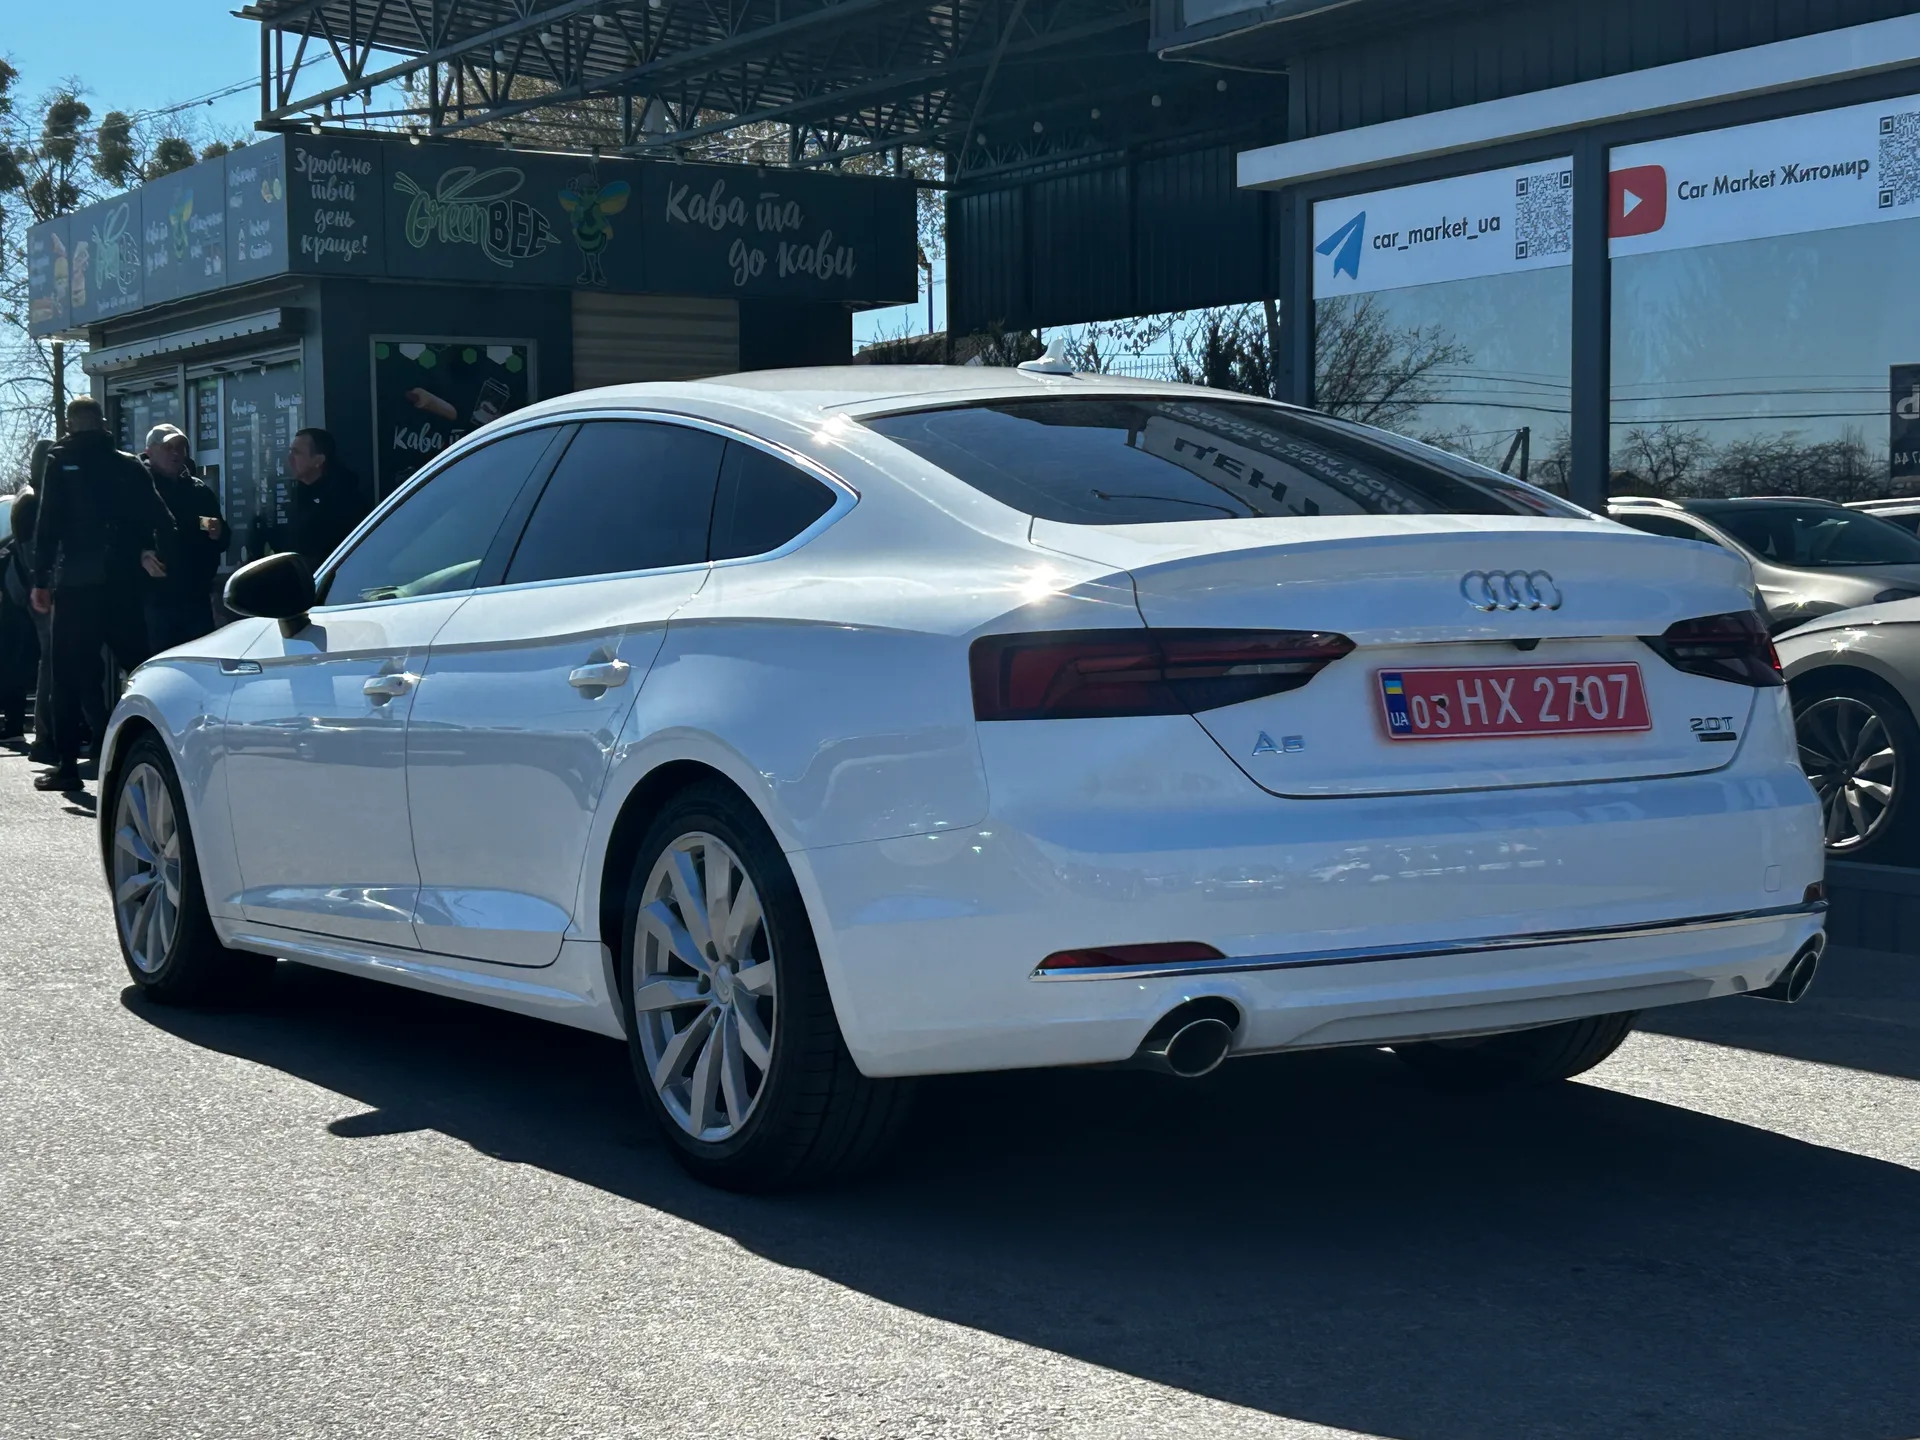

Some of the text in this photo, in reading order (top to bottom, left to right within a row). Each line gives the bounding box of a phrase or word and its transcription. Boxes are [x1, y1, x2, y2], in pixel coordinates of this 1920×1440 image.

[294, 147, 372, 182] Зробимо
[1678, 158, 1870, 200] Car Market Житомир
[311, 174, 355, 201] твій
[314, 208, 355, 234] день
[666, 179, 804, 232] Кава та
[301, 234, 369, 263] краще!
[1373, 216, 1500, 251] car_market_ua
[728, 229, 856, 287] до кави
[393, 422, 443, 454] Кава
[1390, 673, 1628, 729] UA 03 HX 2707
[1251, 731, 1306, 757] A5
